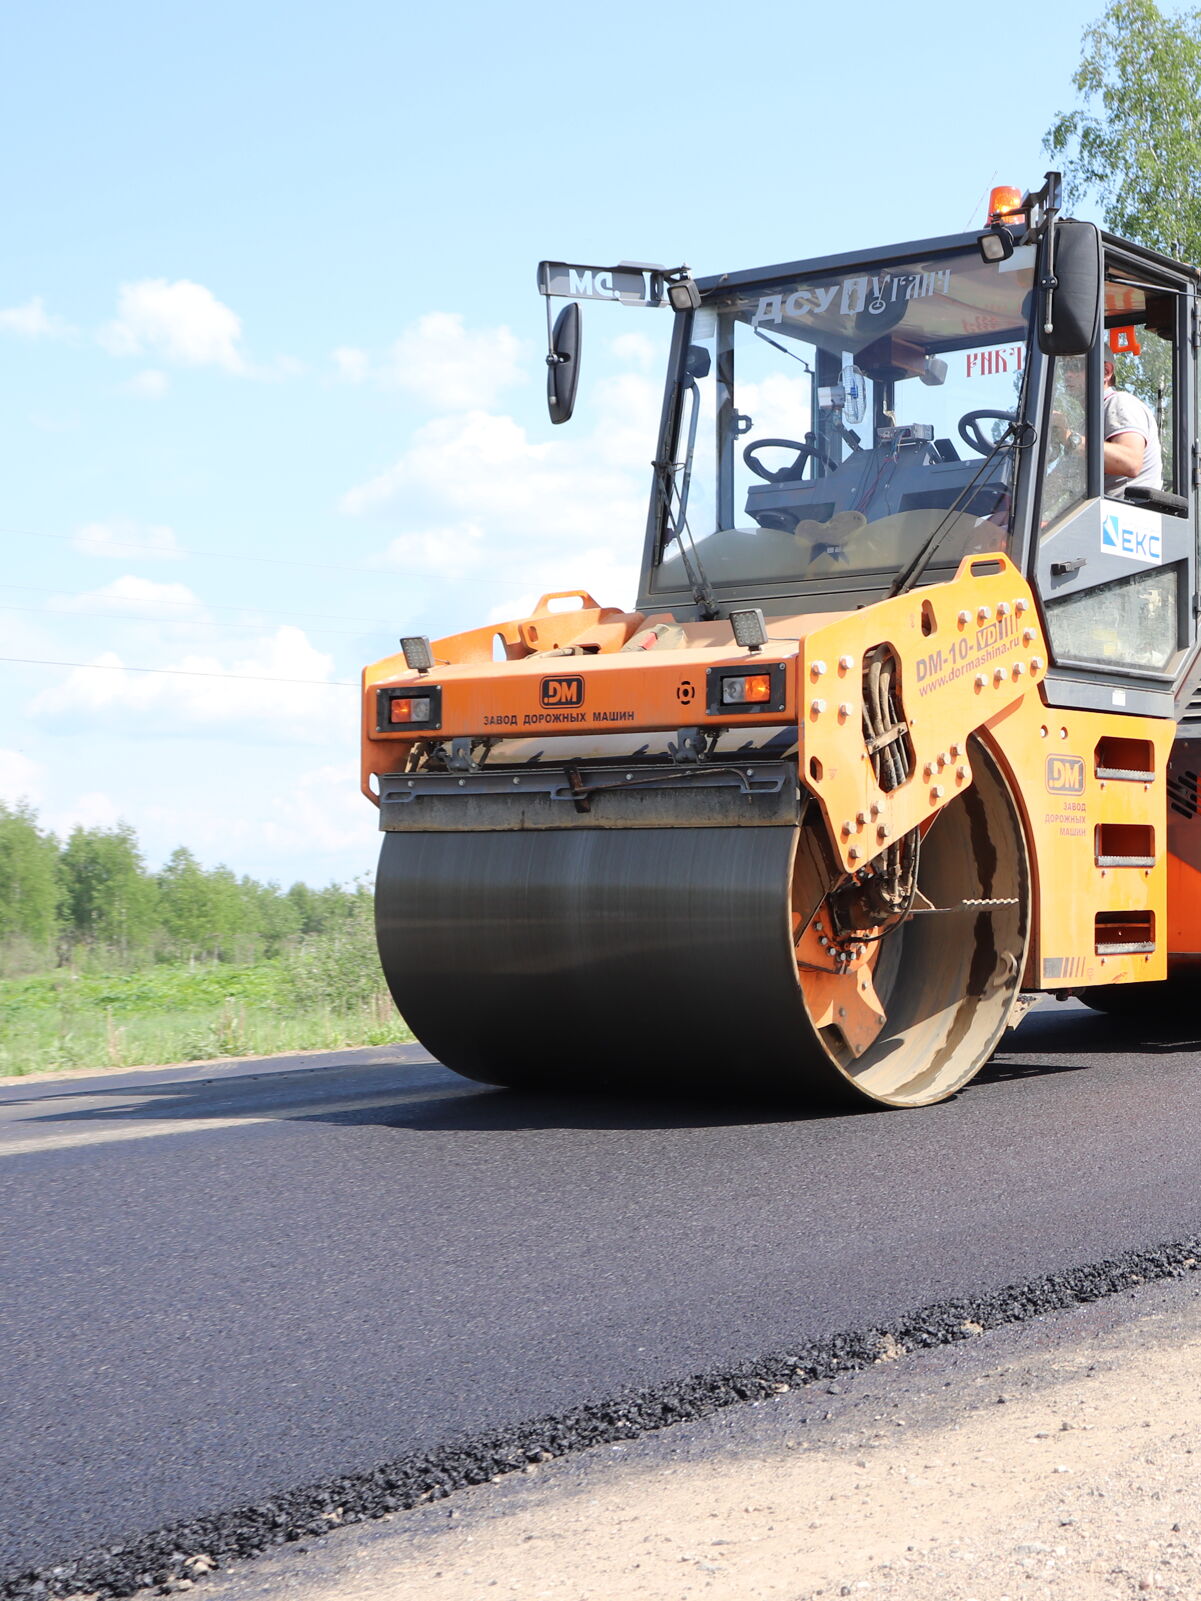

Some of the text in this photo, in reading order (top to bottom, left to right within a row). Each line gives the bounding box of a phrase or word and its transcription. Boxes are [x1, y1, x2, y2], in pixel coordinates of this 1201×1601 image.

[751, 286, 840, 327] ДСУ
[919, 636, 1020, 697] www.dormashina.ru
[483, 711, 635, 726] ЗАВОД ДОРОЖНЫХ МАШИН
[1063, 802, 1086, 812] ЗАВОД
[1045, 814, 1086, 824] ДОРОЖНЫХ
[1060, 827, 1086, 836] МАШИН
